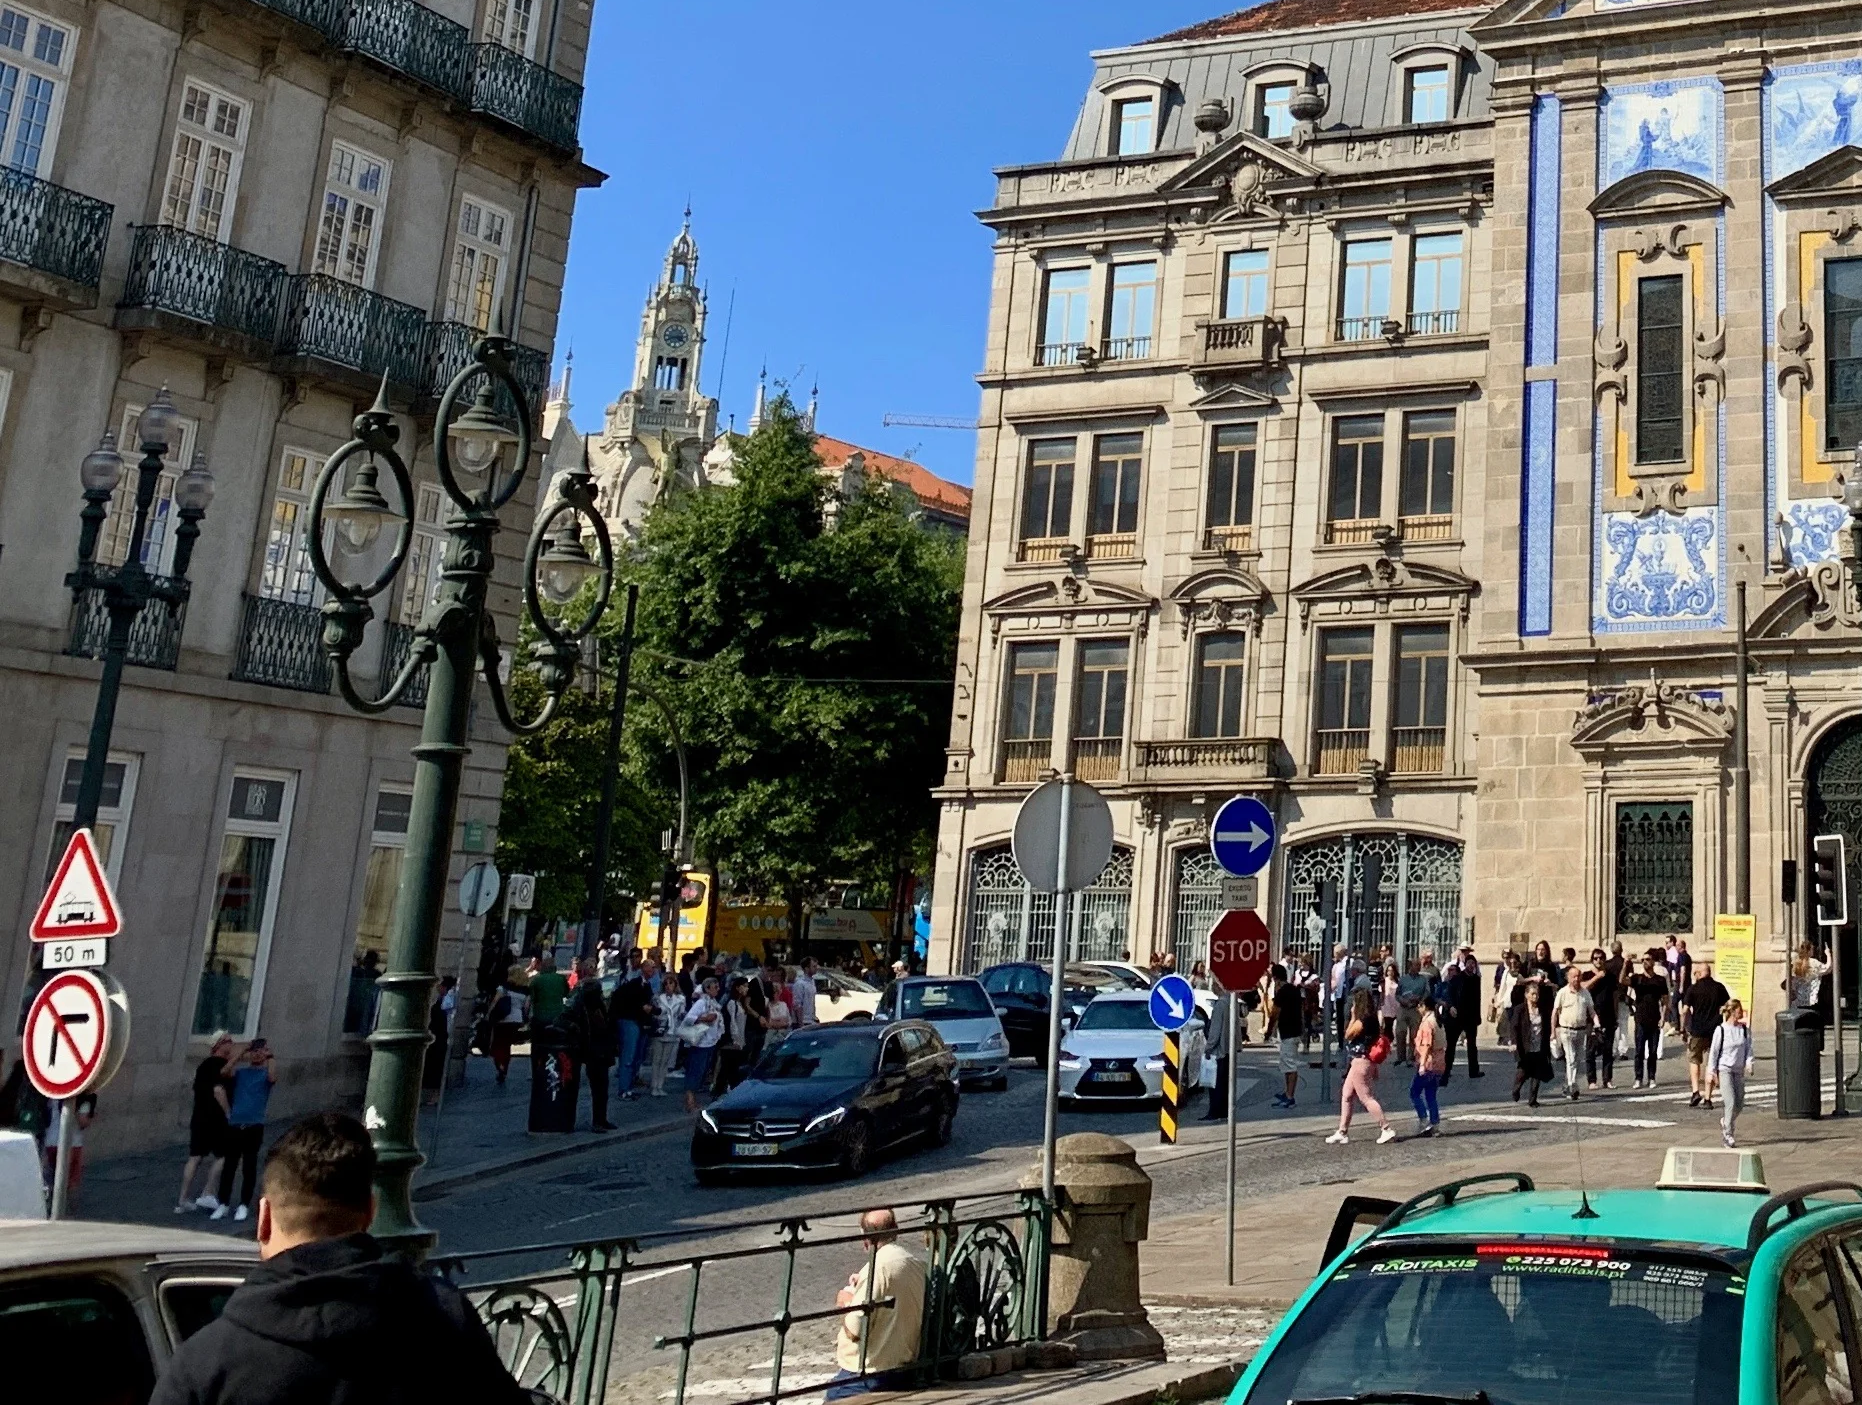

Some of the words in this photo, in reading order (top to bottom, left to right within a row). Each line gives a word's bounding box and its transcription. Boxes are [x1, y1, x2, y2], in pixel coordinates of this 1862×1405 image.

[54, 945, 74, 963] 50
[82, 948, 95, 961] m
[1213, 939, 1268, 963] STOP
[1502, 1264, 1626, 1279] www.raditaxis.pt
[1521, 1256, 1556, 1265] 225
[1559, 1258, 1593, 1267] 073
[1596, 1260, 1632, 1271] 900
